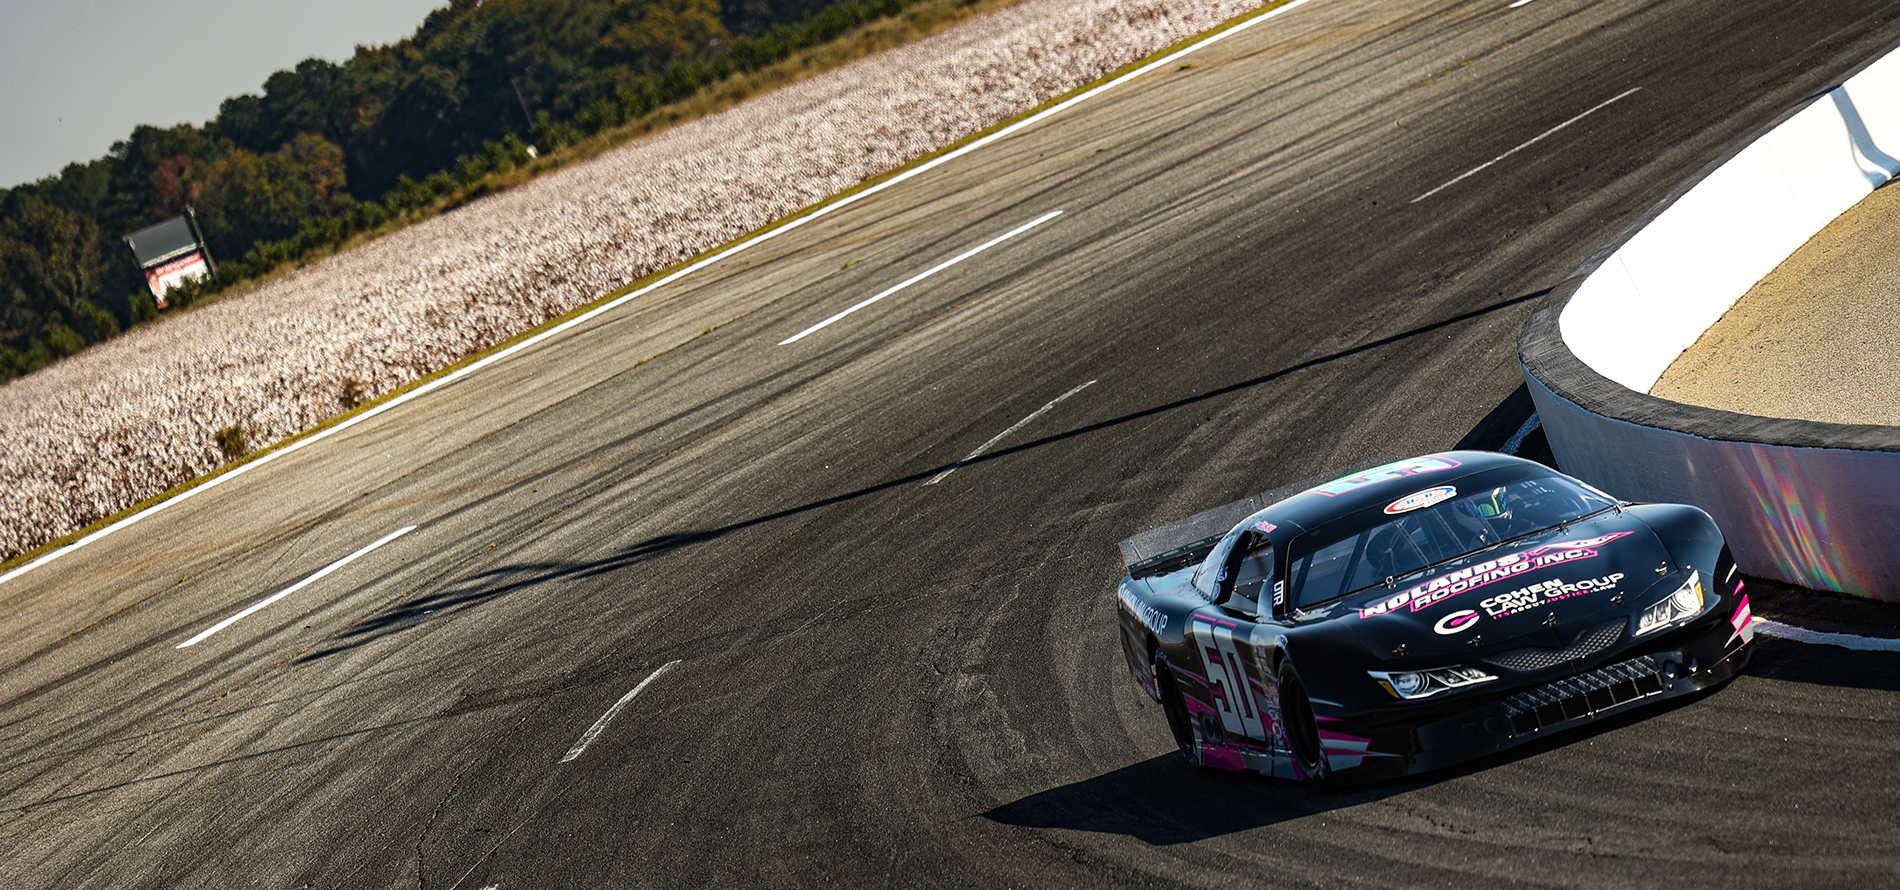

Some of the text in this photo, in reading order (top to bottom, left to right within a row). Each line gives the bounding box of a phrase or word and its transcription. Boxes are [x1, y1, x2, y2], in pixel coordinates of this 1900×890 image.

[1363, 553, 1521, 617] NOLANDS
[1414, 548, 1590, 609] ROOFING INC.
[1480, 578, 1564, 609] COHEN
[1485, 572, 1625, 617] LAW GROUP
[1192, 620, 1265, 741] 50
